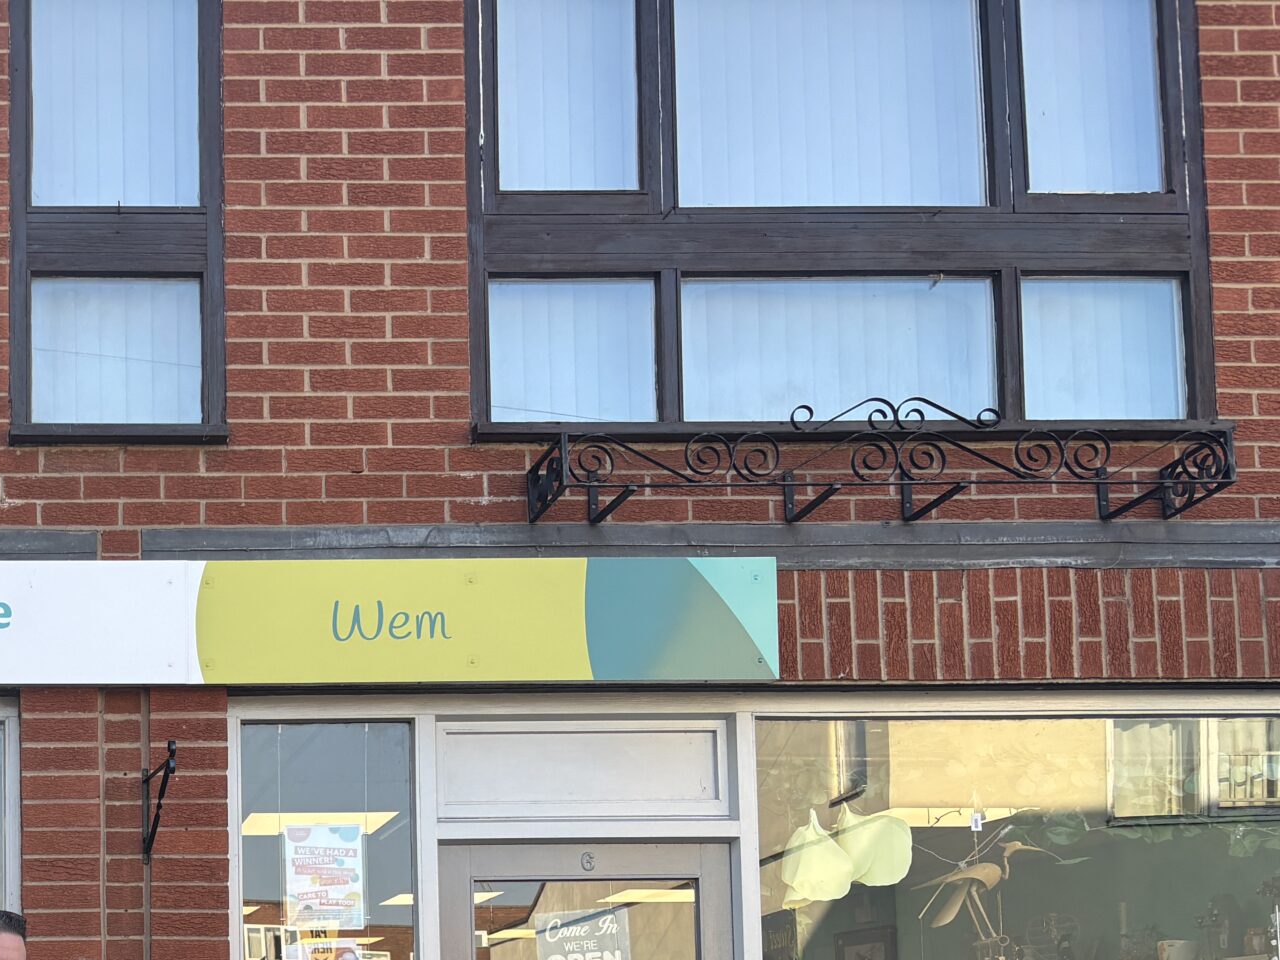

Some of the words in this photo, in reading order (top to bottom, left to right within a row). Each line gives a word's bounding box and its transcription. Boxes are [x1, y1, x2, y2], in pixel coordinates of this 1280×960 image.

[331, 599, 452, 642] Wem
[326, 848, 346, 856] HAD
[348, 849, 354, 857] A
[581, 851, 595, 872] 6
[545, 918, 590, 942] Come
[595, 915, 620, 936] In
[564, 940, 598, 952] WE'RE
